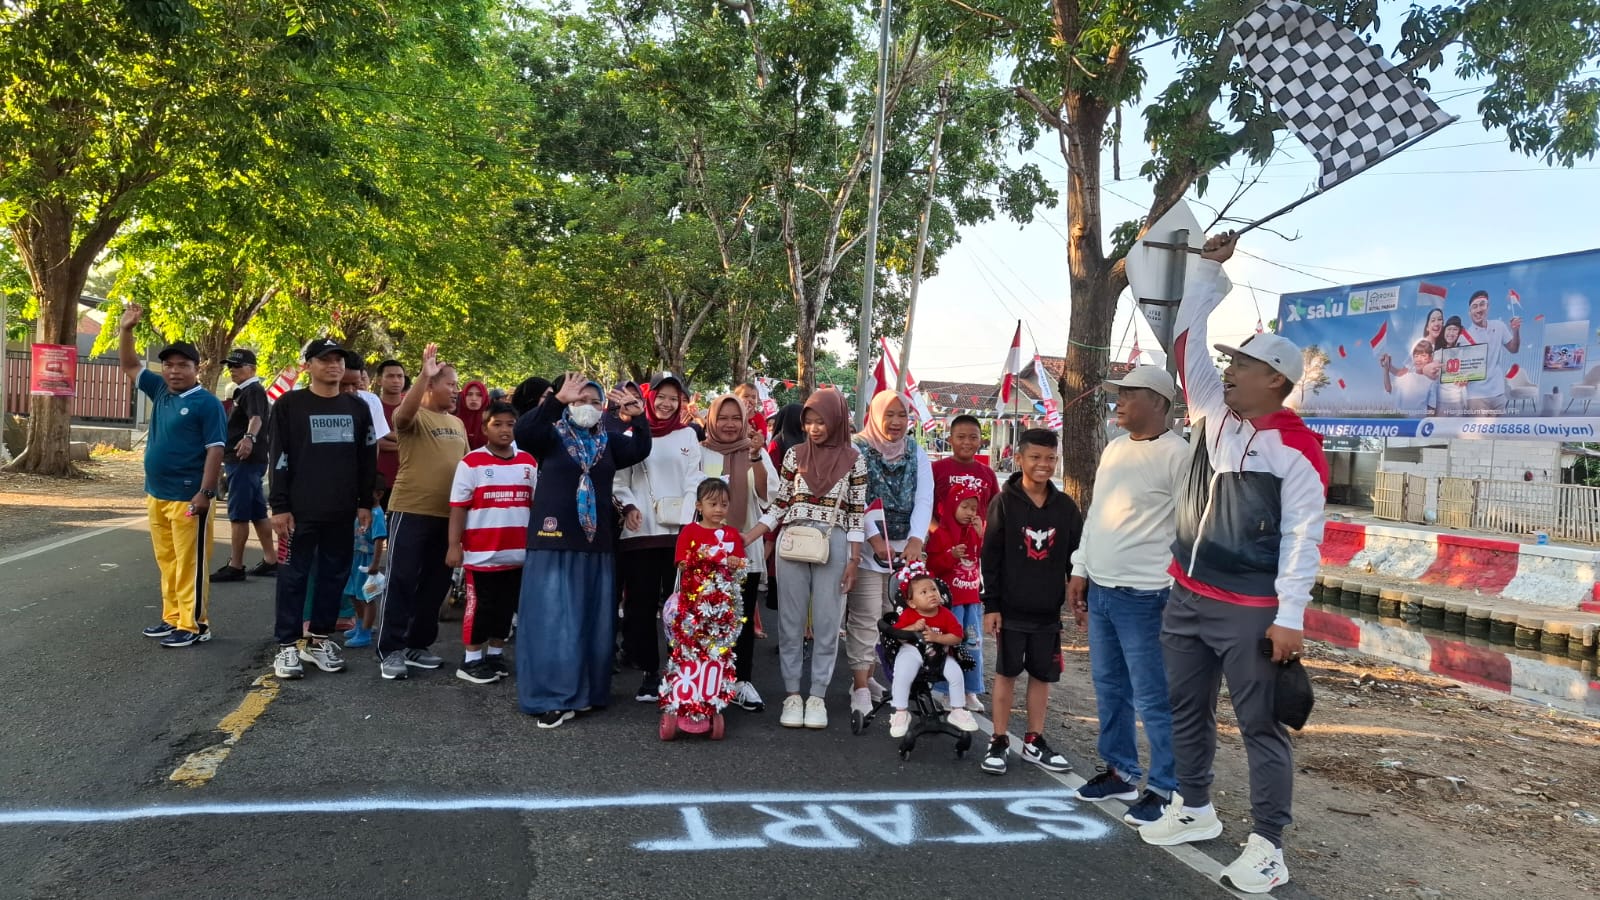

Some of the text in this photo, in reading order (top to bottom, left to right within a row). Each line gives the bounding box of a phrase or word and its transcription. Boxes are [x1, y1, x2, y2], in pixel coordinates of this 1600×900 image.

[1336, 425, 1399, 436] SEKARANG
[1462, 423, 1594, 437] 0818815858 (Dwiyan)
[631, 799, 1109, 851] START
